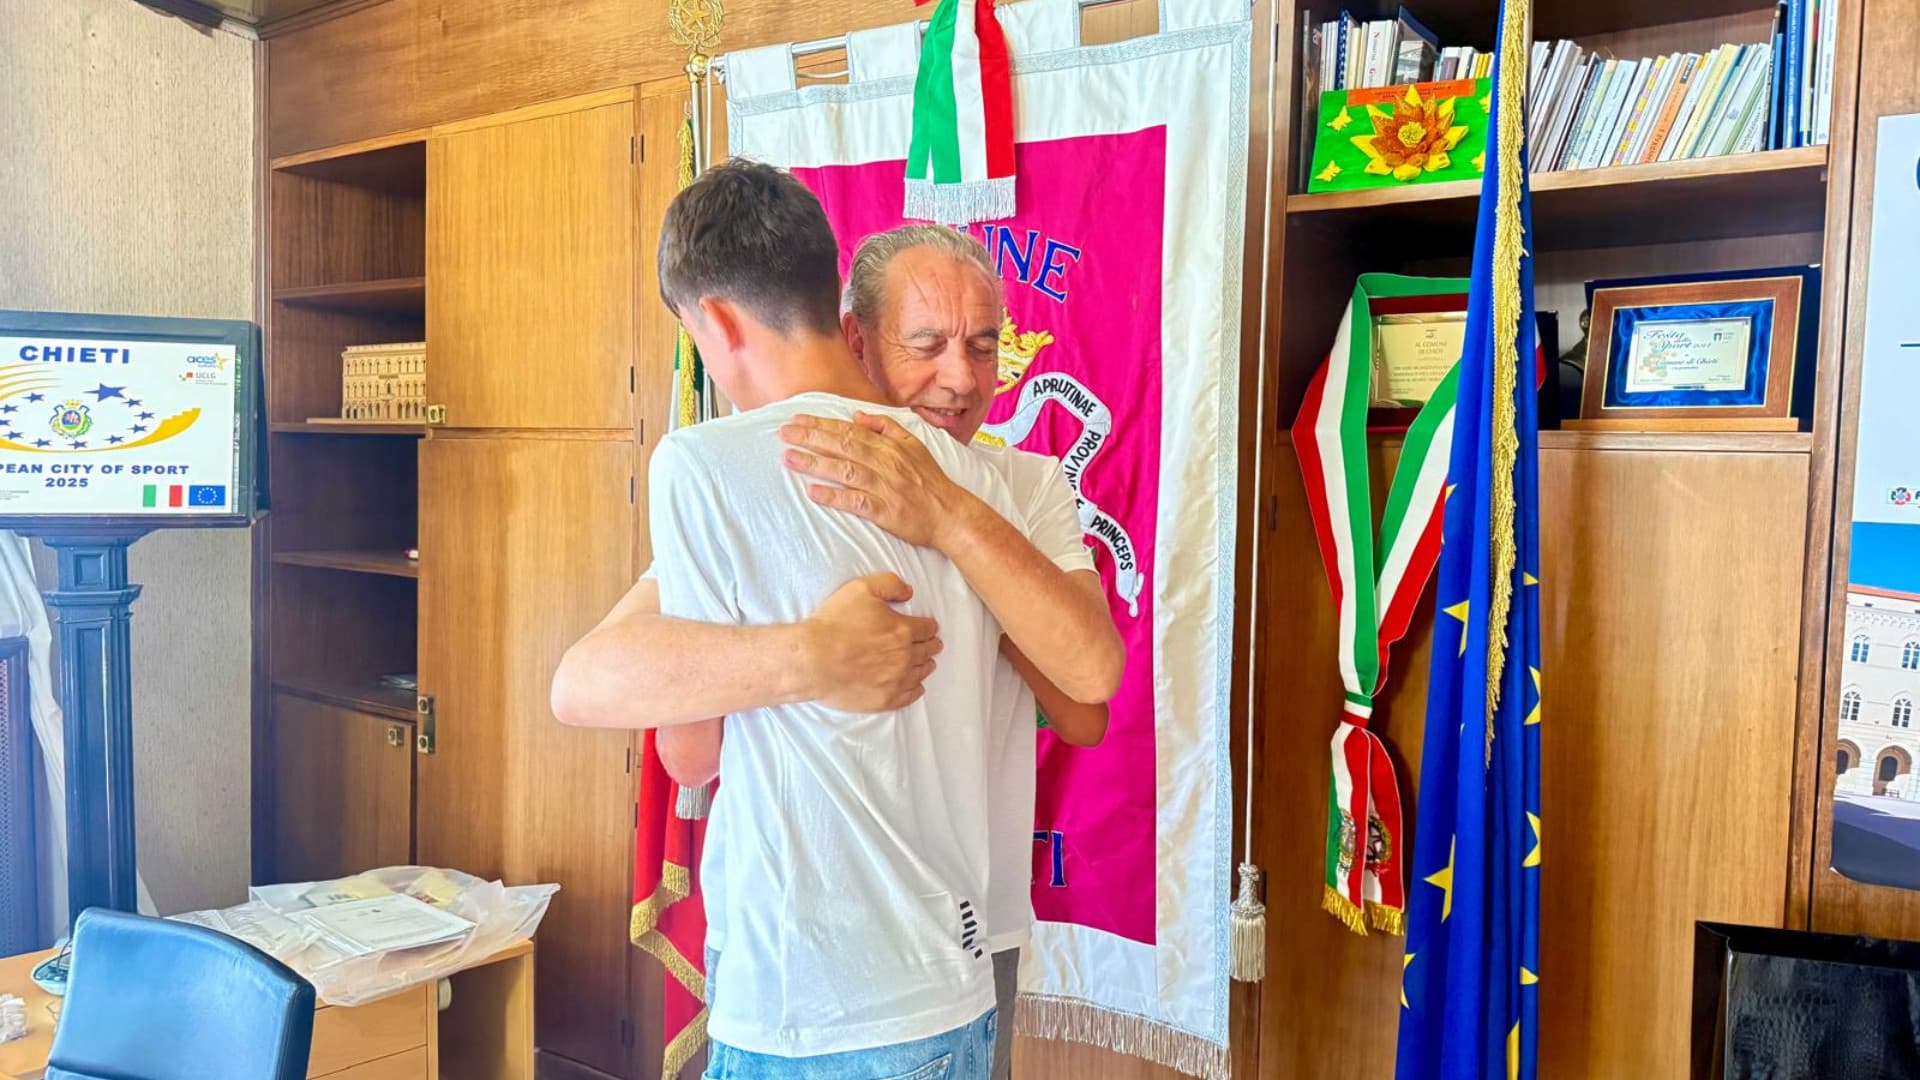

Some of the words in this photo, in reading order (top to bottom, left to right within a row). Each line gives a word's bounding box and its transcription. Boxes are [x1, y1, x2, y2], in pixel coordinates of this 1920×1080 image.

[19, 345, 130, 364] CHIETI
[51, 464, 94, 475] CITY
[101, 464, 125, 475] OF
[131, 465, 190, 476] SPORT
[1033, 377, 1097, 417] APRUTINAE
[1090, 514, 1134, 571] PRINCEPS
[45, 477, 89, 488] 2025
